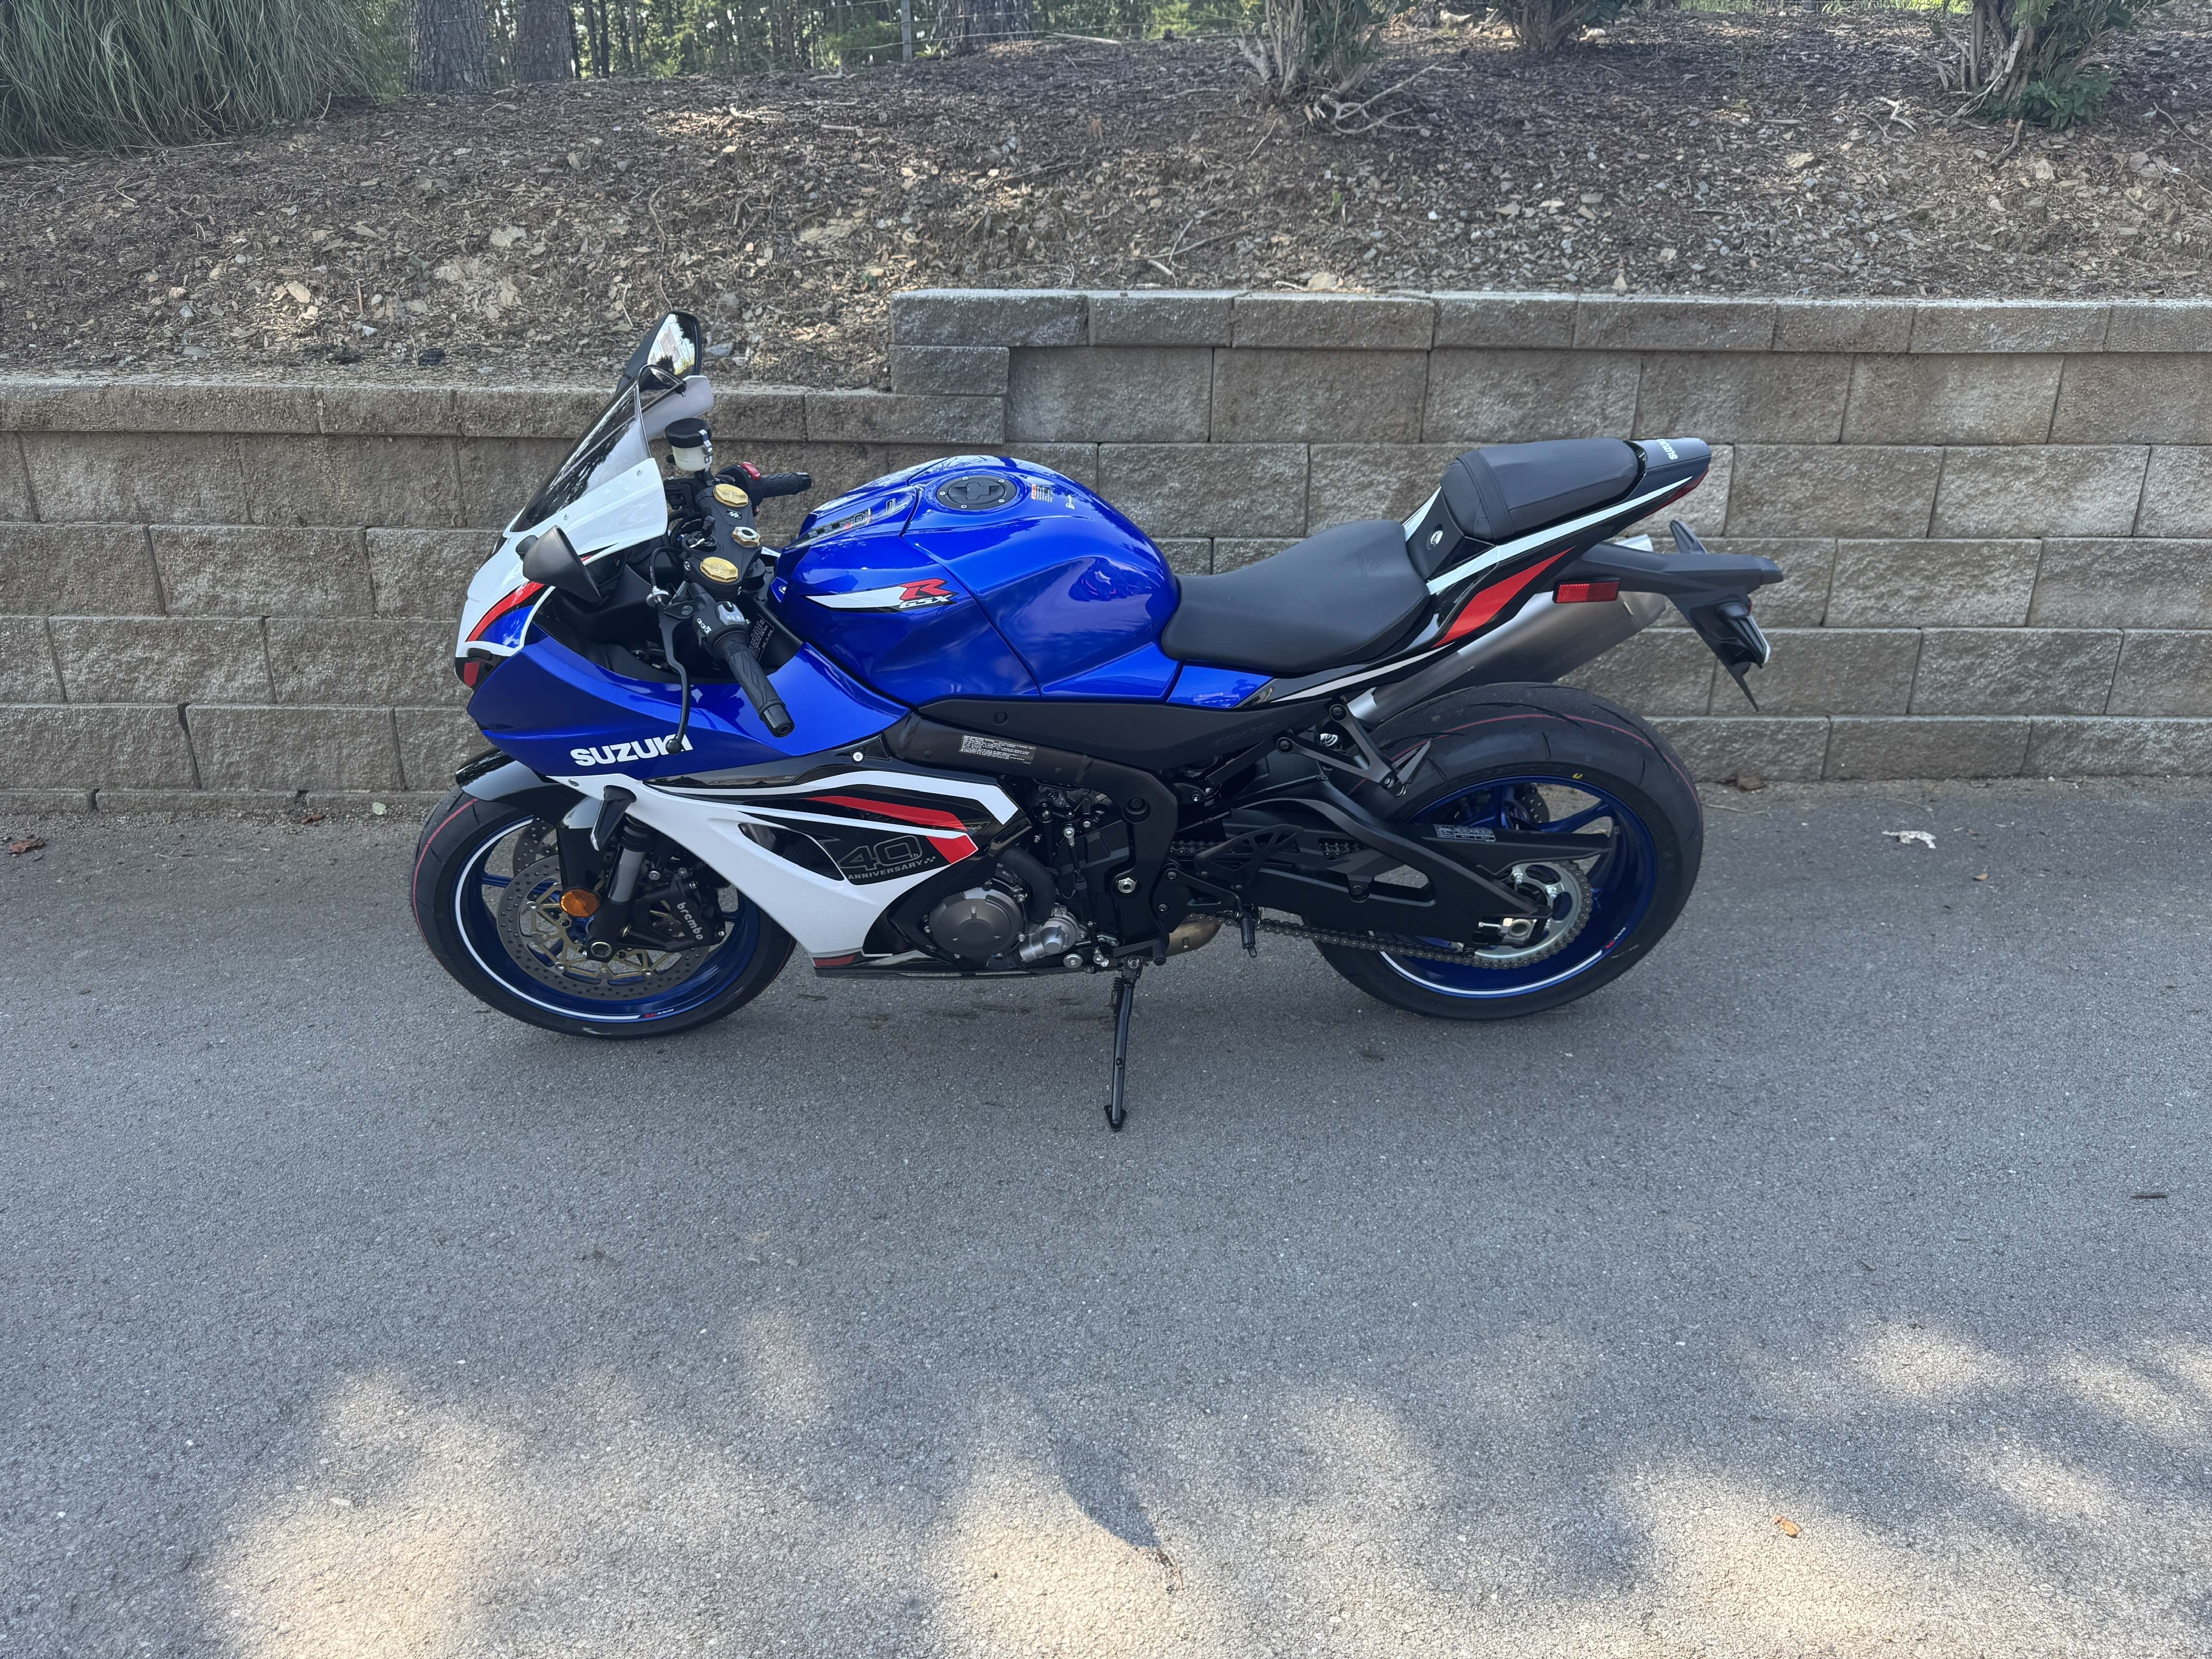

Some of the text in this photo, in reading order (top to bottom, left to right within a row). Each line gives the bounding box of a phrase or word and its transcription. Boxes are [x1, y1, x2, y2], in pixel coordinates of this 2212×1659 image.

[899, 578, 953, 600] R
[899, 594, 953, 609] GSX
[848, 860, 923, 880] ANNIVERSARY
[677, 902, 703, 940] brembo
